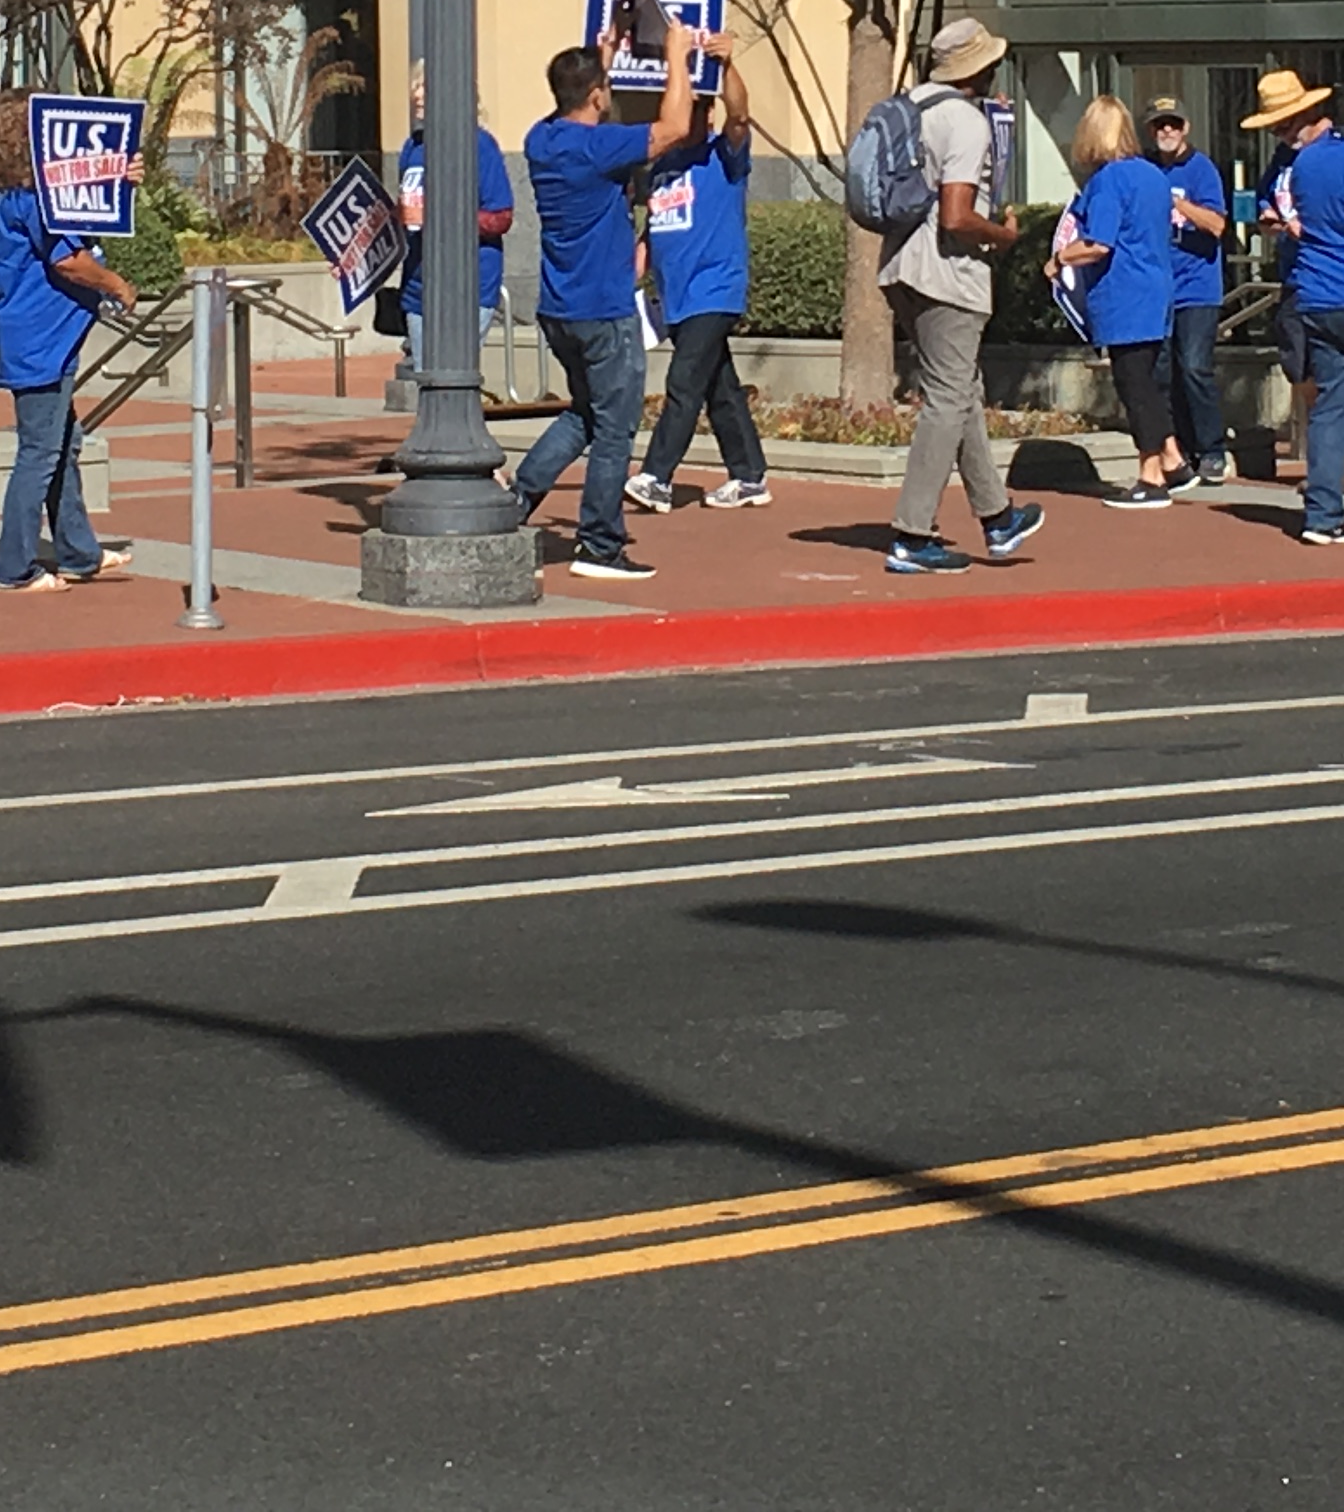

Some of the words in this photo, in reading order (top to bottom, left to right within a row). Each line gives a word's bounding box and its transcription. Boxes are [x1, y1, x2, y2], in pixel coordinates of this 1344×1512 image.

[53, 121, 113, 159] U.S.
[46, 165, 67, 185] NOT
[69, 160, 90, 180] FOR
[94, 155, 125, 176] SALE
[58, 185, 111, 211] MAIL
[327, 193, 373, 245] U.S.
